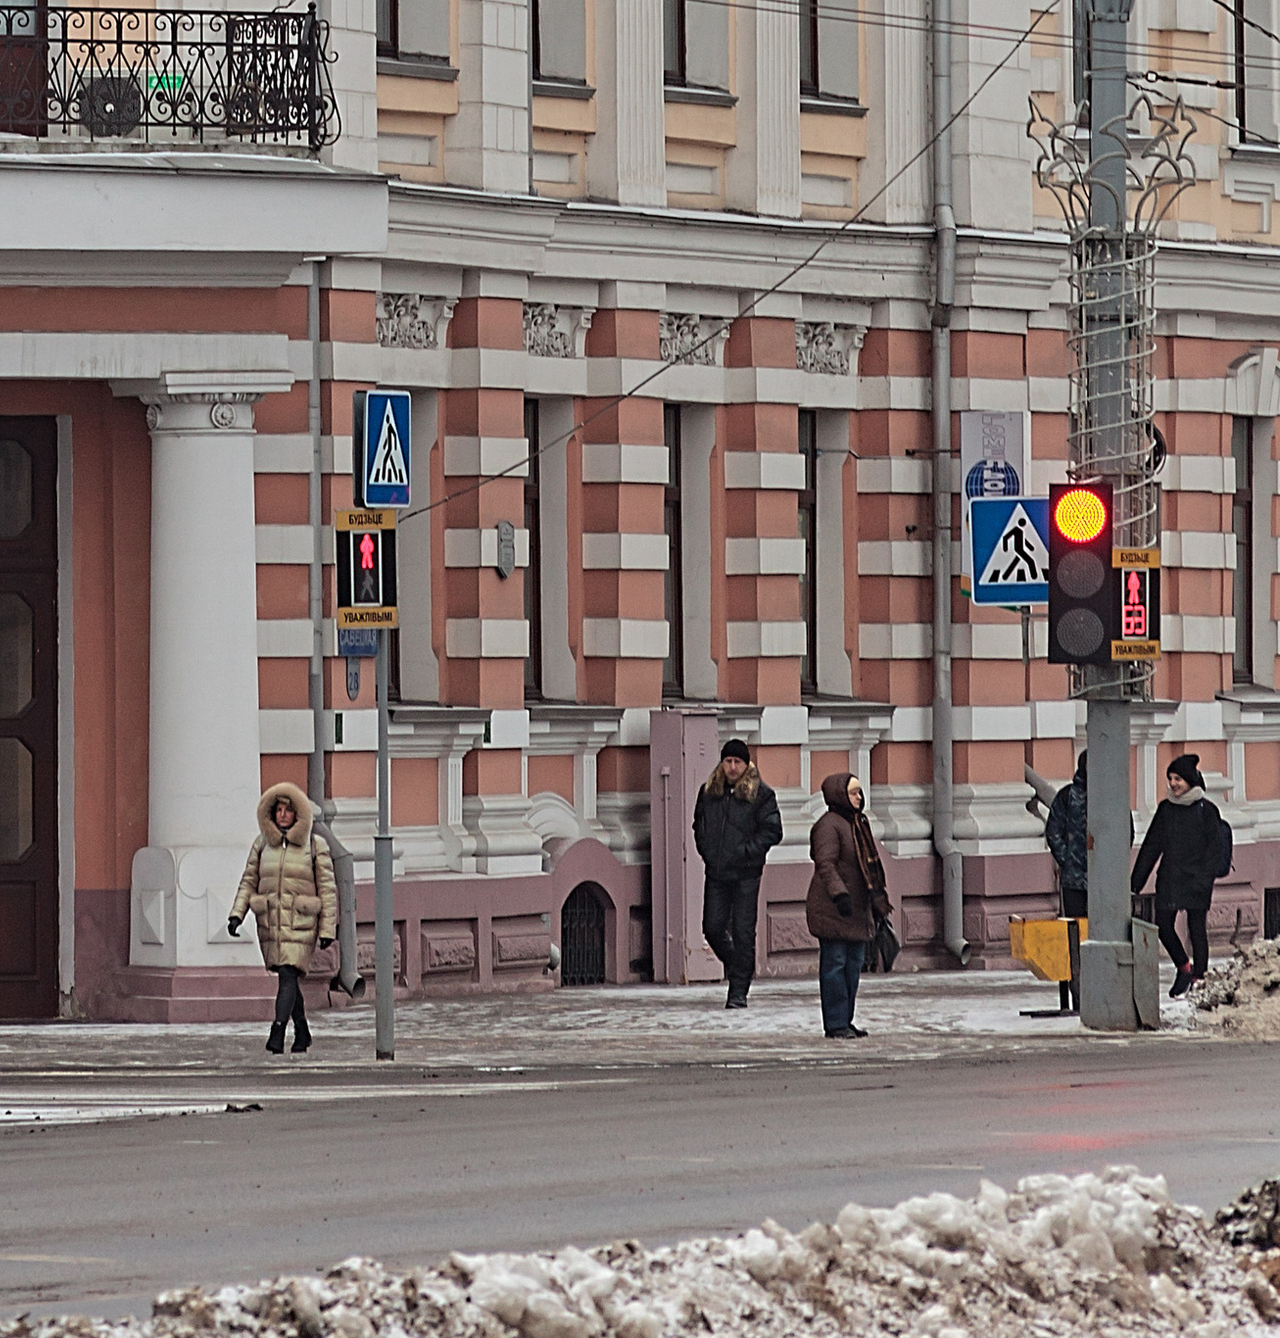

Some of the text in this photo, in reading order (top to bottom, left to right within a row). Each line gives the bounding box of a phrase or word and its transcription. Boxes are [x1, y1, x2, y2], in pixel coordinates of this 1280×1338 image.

[348, 513, 383, 525] БУДЗЬЦЕ
[344, 611, 393, 623] УВАЖЛІВЫМІ
[1123, 605, 1146, 635] 63
[348, 671, 359, 692] 28
